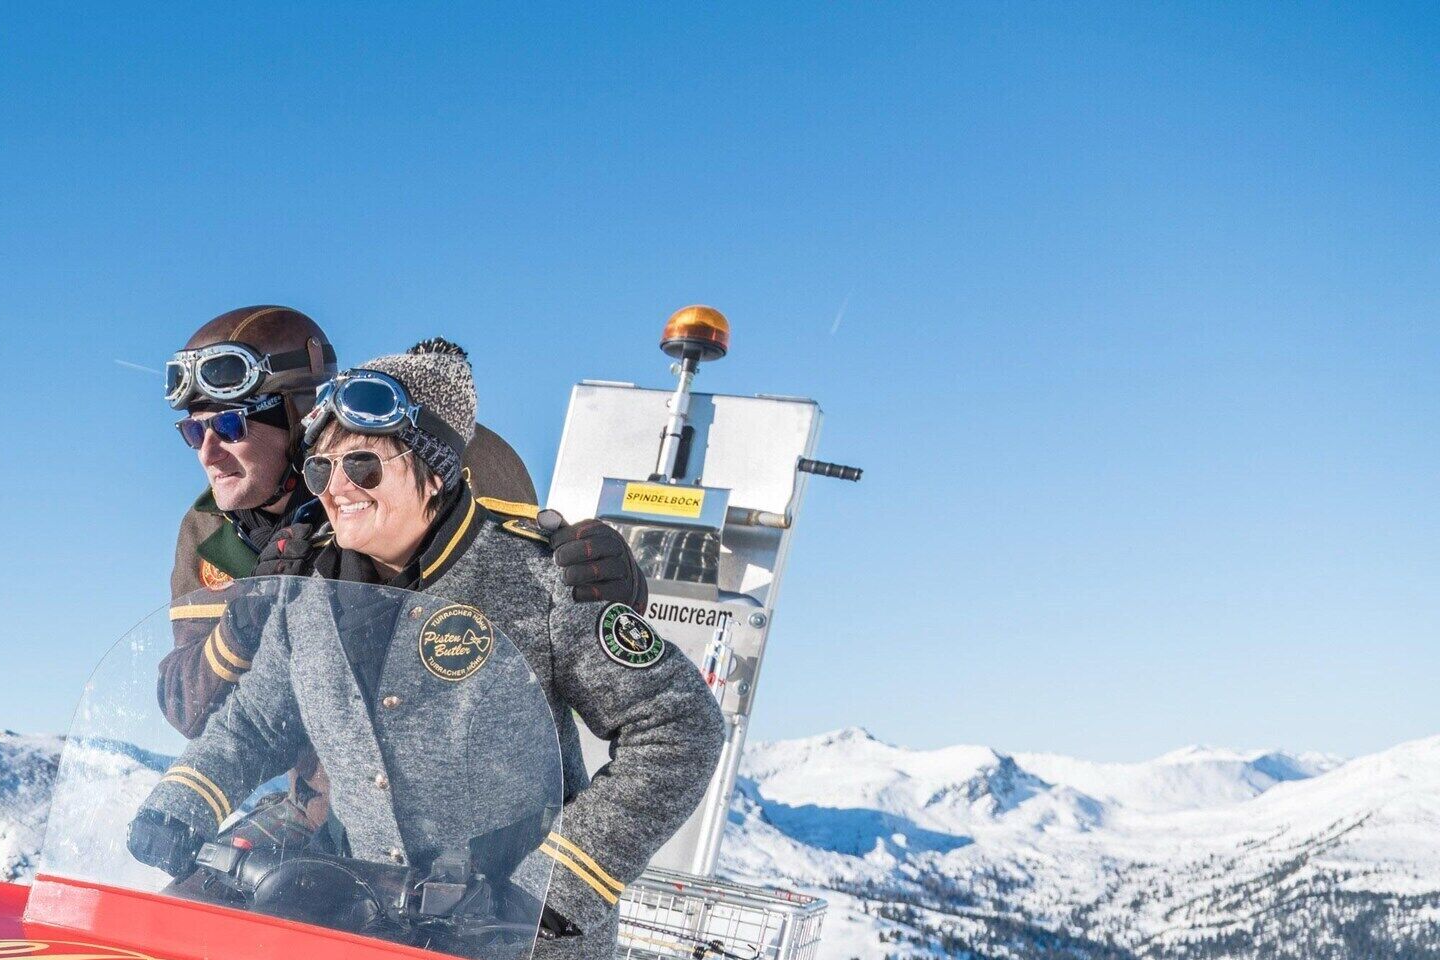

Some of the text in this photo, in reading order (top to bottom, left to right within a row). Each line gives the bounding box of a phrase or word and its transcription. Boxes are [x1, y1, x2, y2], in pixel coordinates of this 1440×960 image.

[431, 609, 472, 627] TURRACHER
[424, 631, 461, 645] Pisten
[434, 643, 471, 656] Butler
[428, 656, 466, 676] TURRACHER
